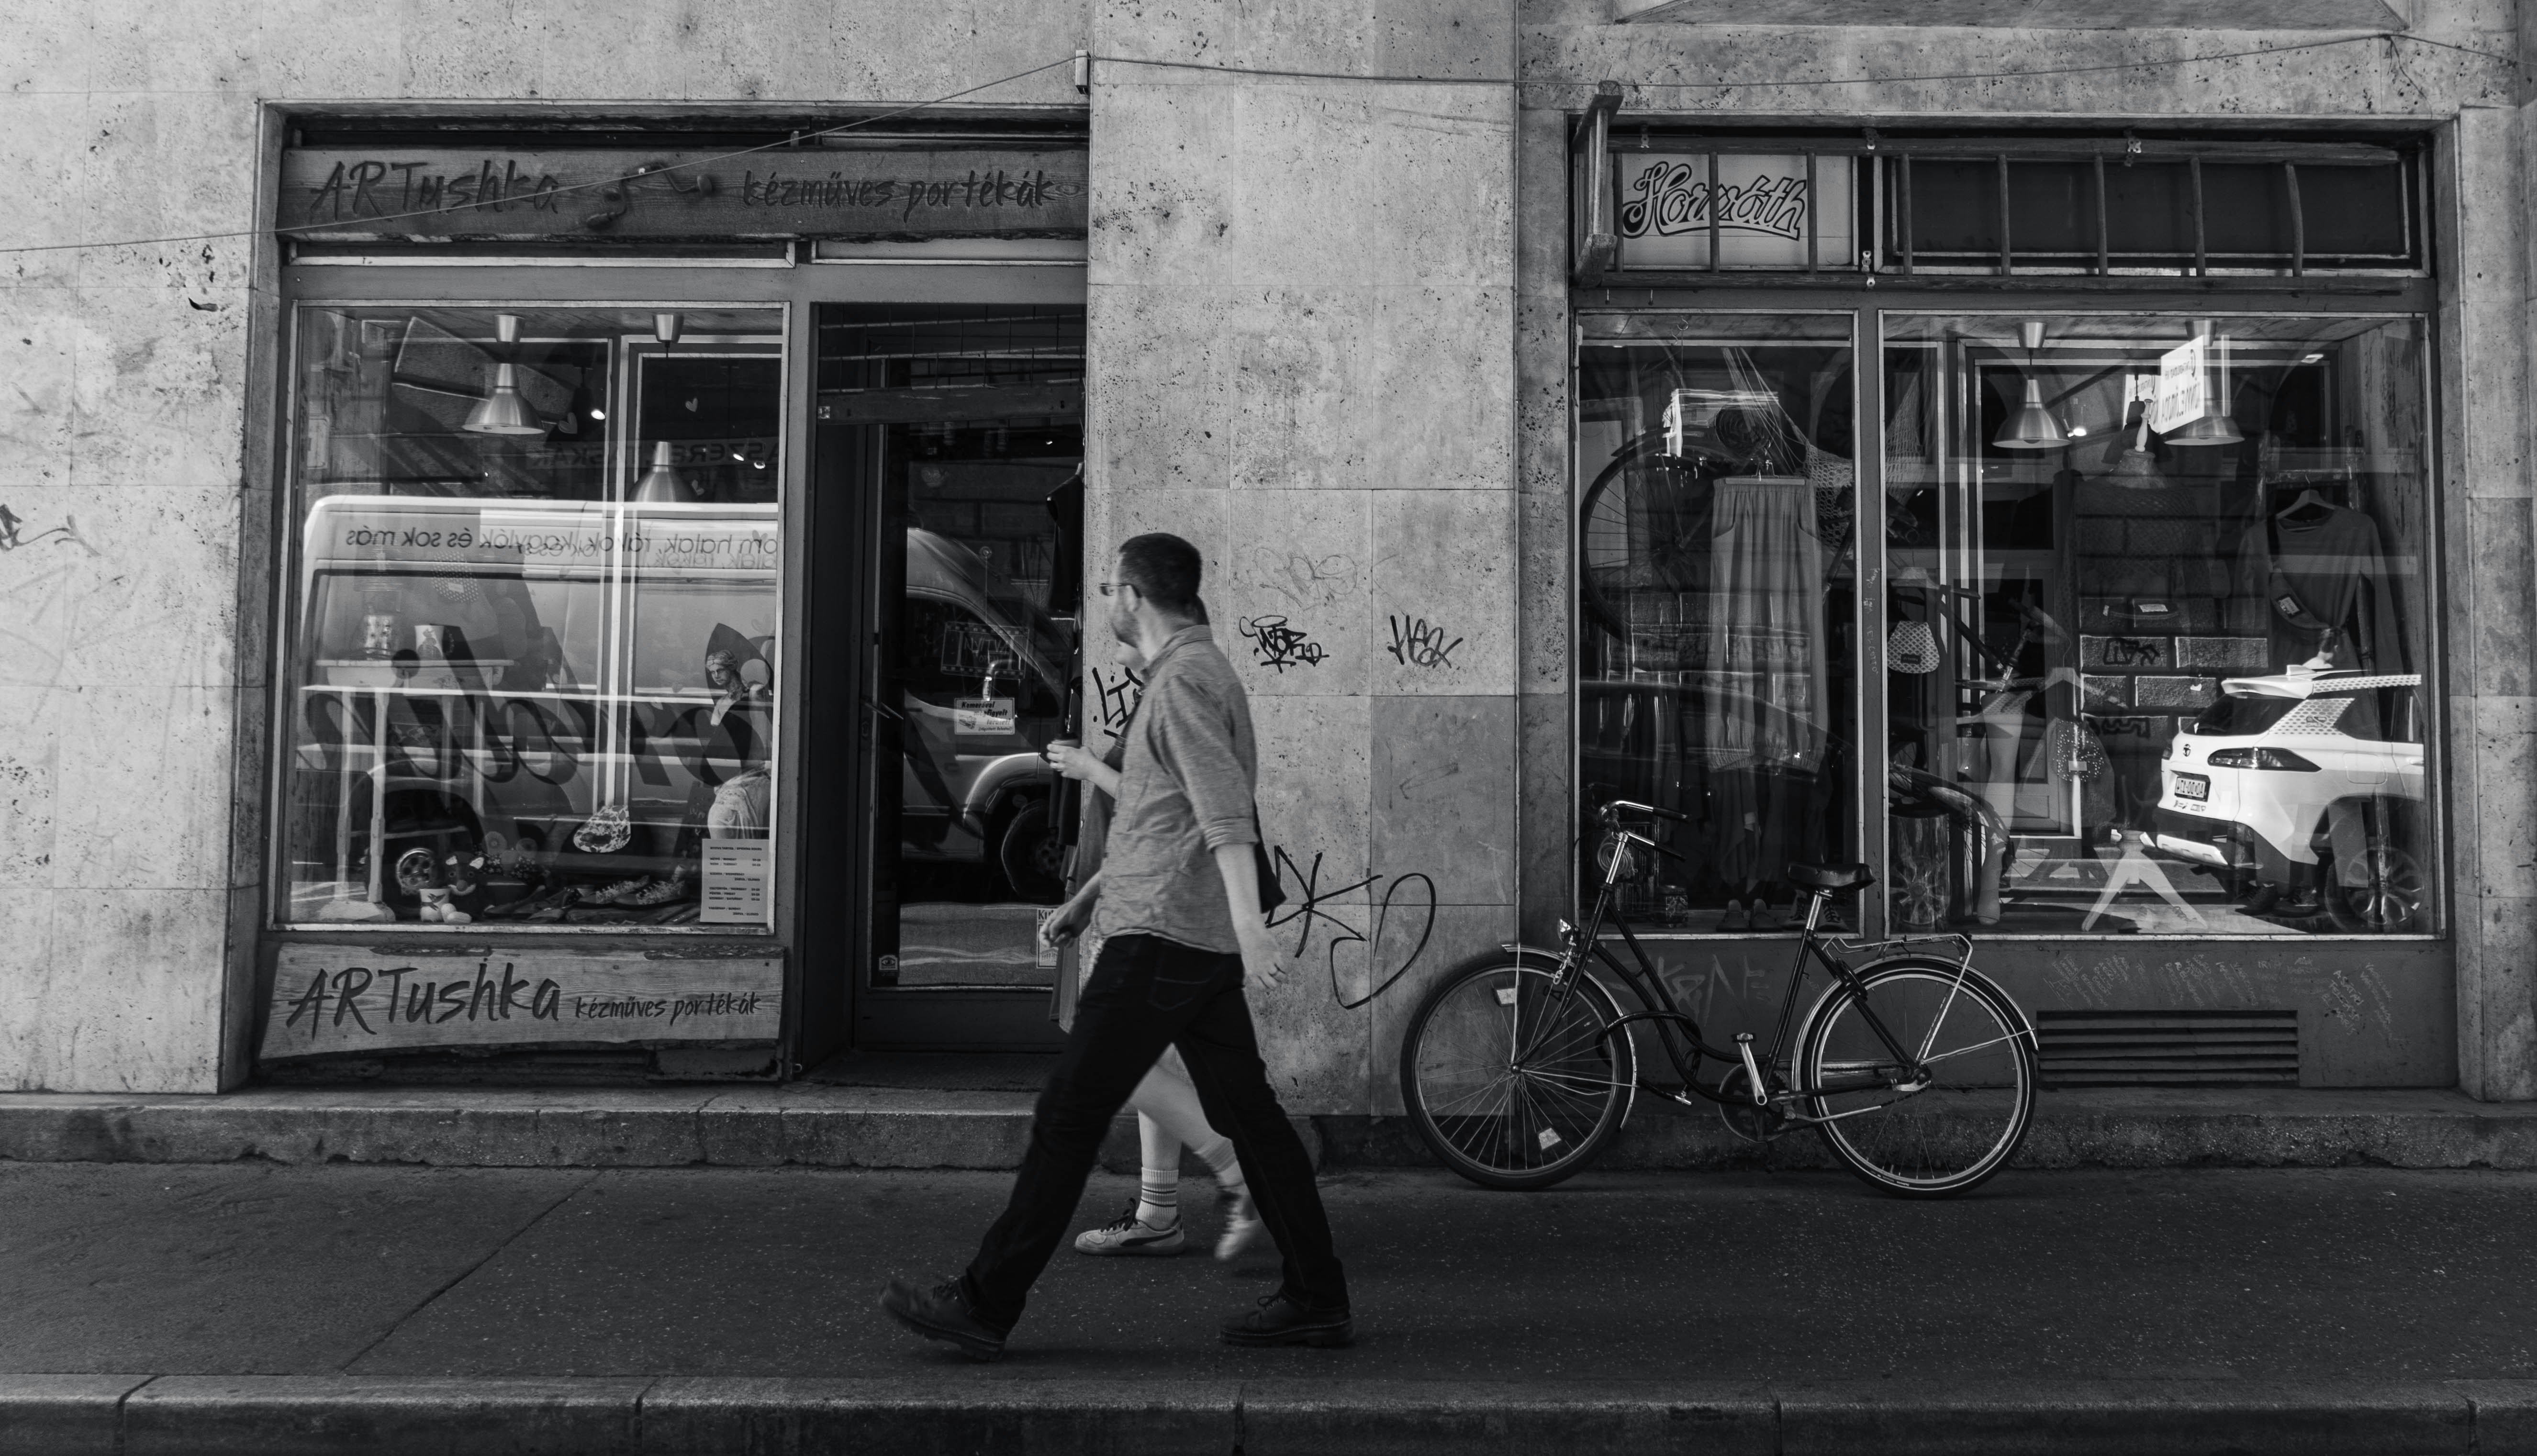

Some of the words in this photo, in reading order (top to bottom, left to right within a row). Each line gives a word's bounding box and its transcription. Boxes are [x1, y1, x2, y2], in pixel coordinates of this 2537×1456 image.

[742, 170, 895, 208] kézműves
[903, 169, 1056, 224] portékák
[287, 958, 561, 1041] ARTushka
[575, 996, 667, 1019] kézműves
[670, 991, 762, 1027] portékák
